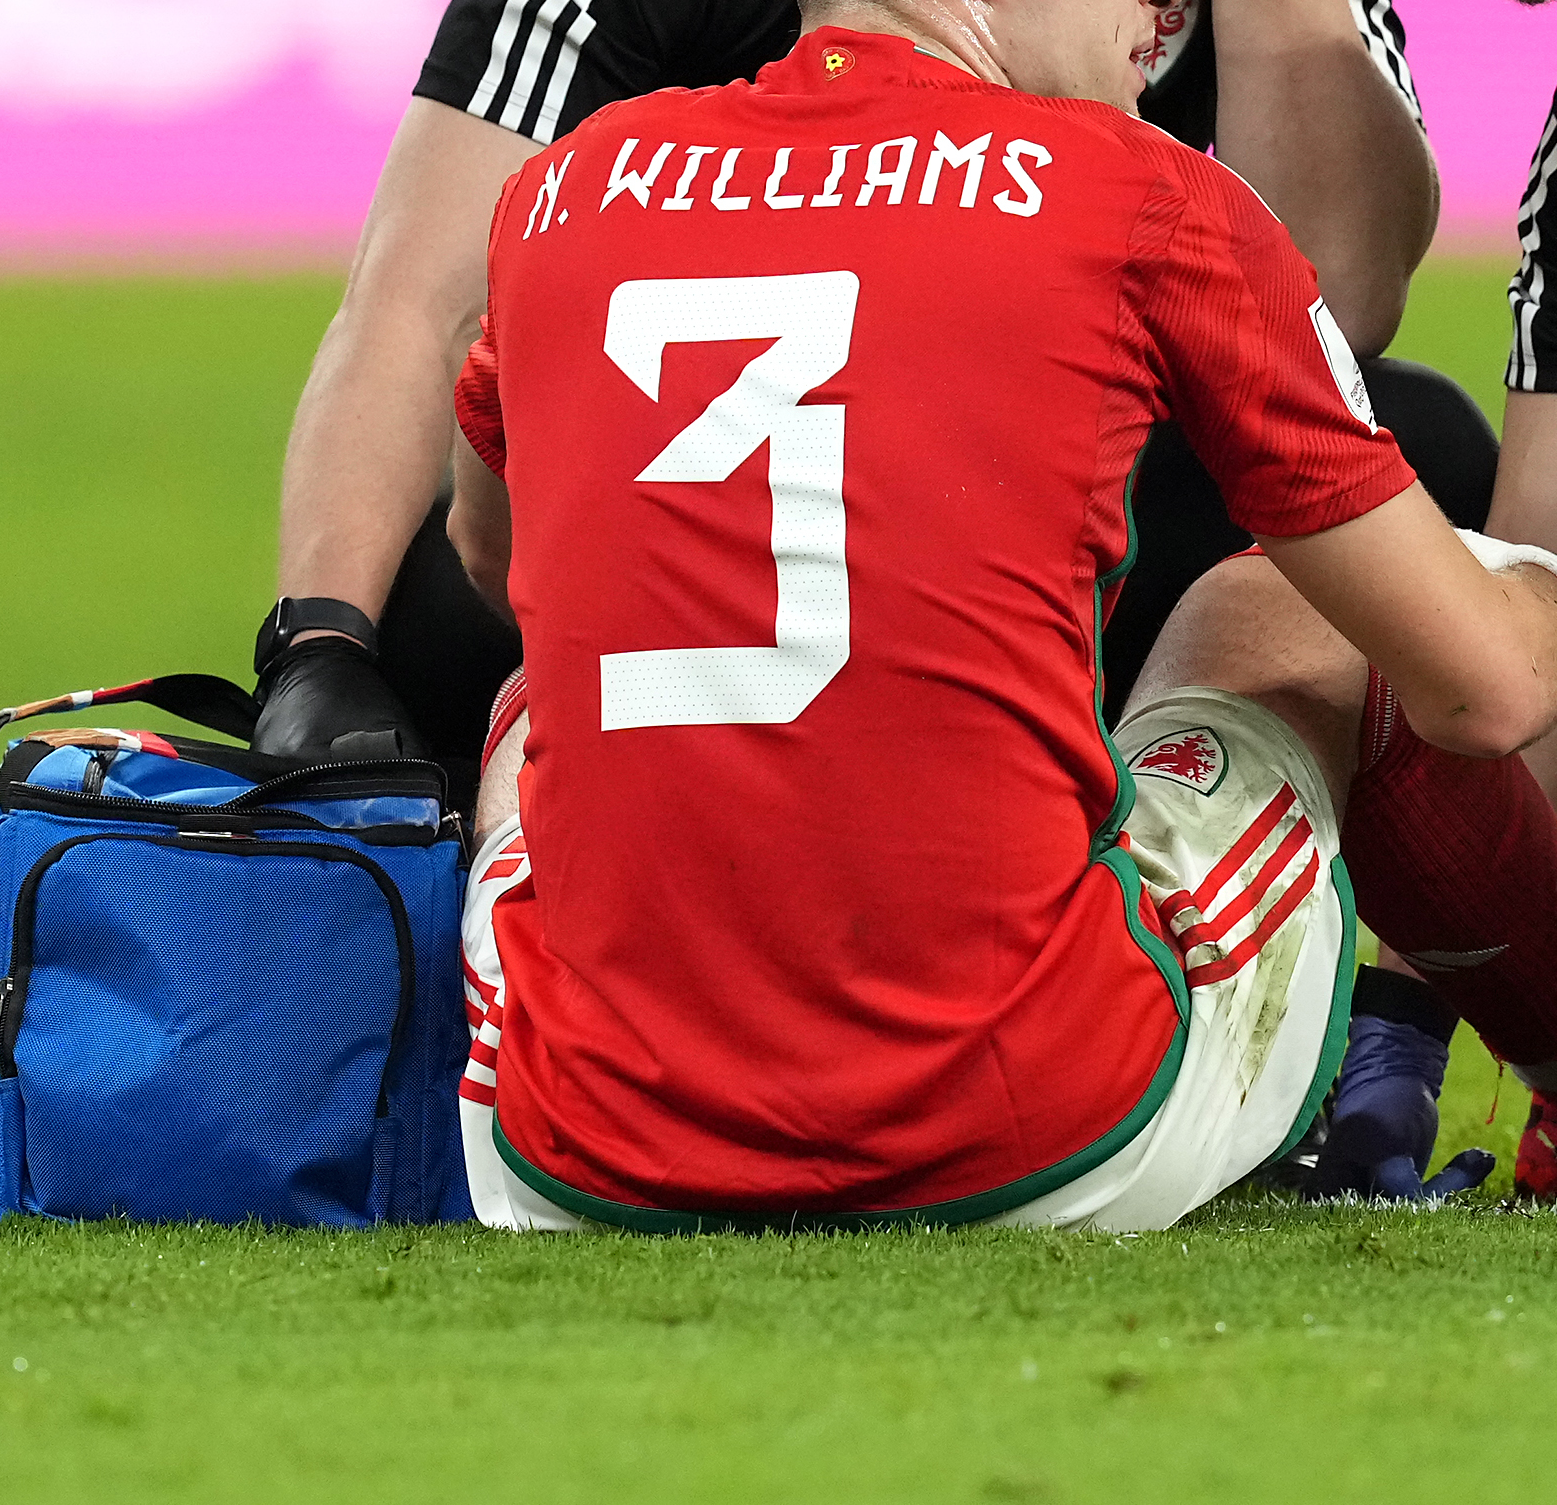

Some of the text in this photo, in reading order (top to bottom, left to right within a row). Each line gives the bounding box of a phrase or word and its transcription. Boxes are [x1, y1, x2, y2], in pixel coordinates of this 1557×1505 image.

[522, 129, 1053, 241] N. WILLIAMS
[599, 270, 860, 732] 3
